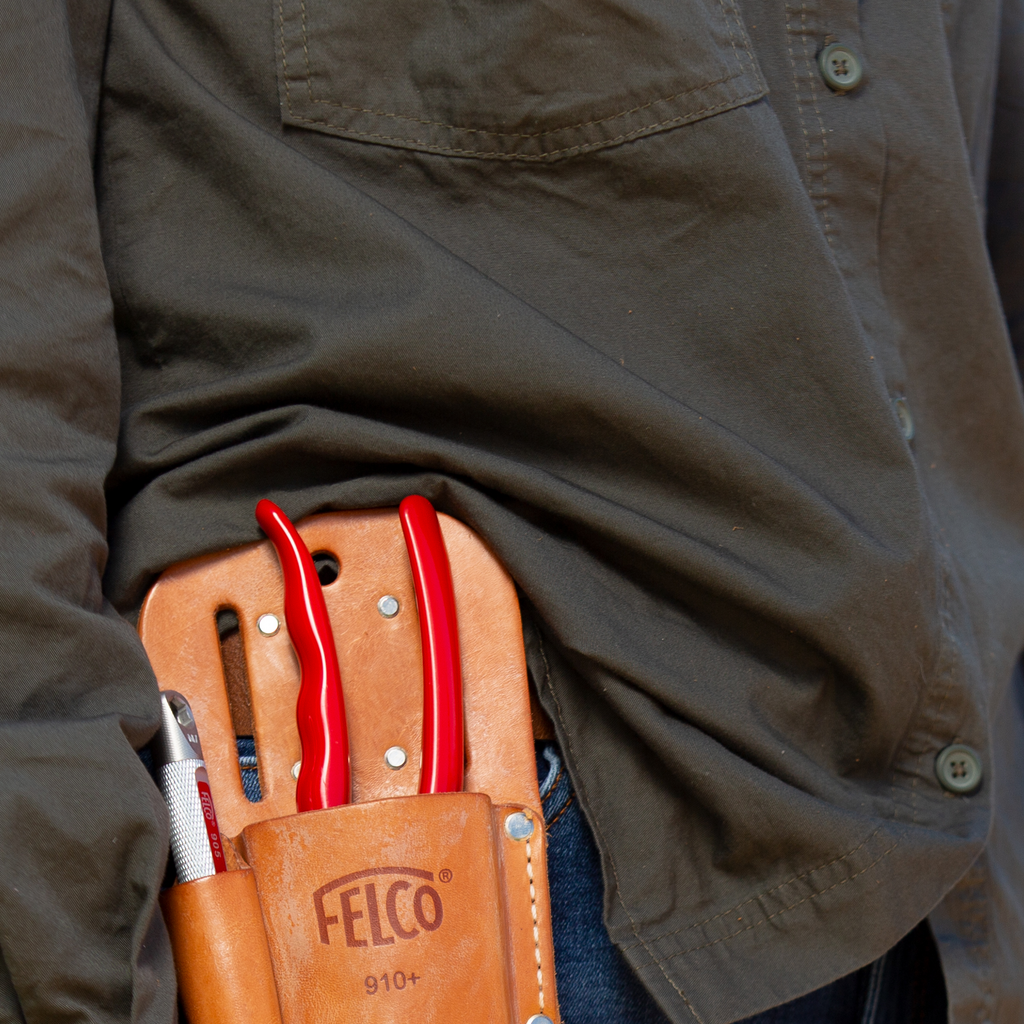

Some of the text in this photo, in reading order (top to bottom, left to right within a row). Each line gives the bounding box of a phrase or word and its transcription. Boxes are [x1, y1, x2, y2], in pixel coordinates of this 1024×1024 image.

[200, 791, 221, 858] FELCO 905
[312, 866, 443, 948] FELCO
[364, 971, 421, 995] 910+
